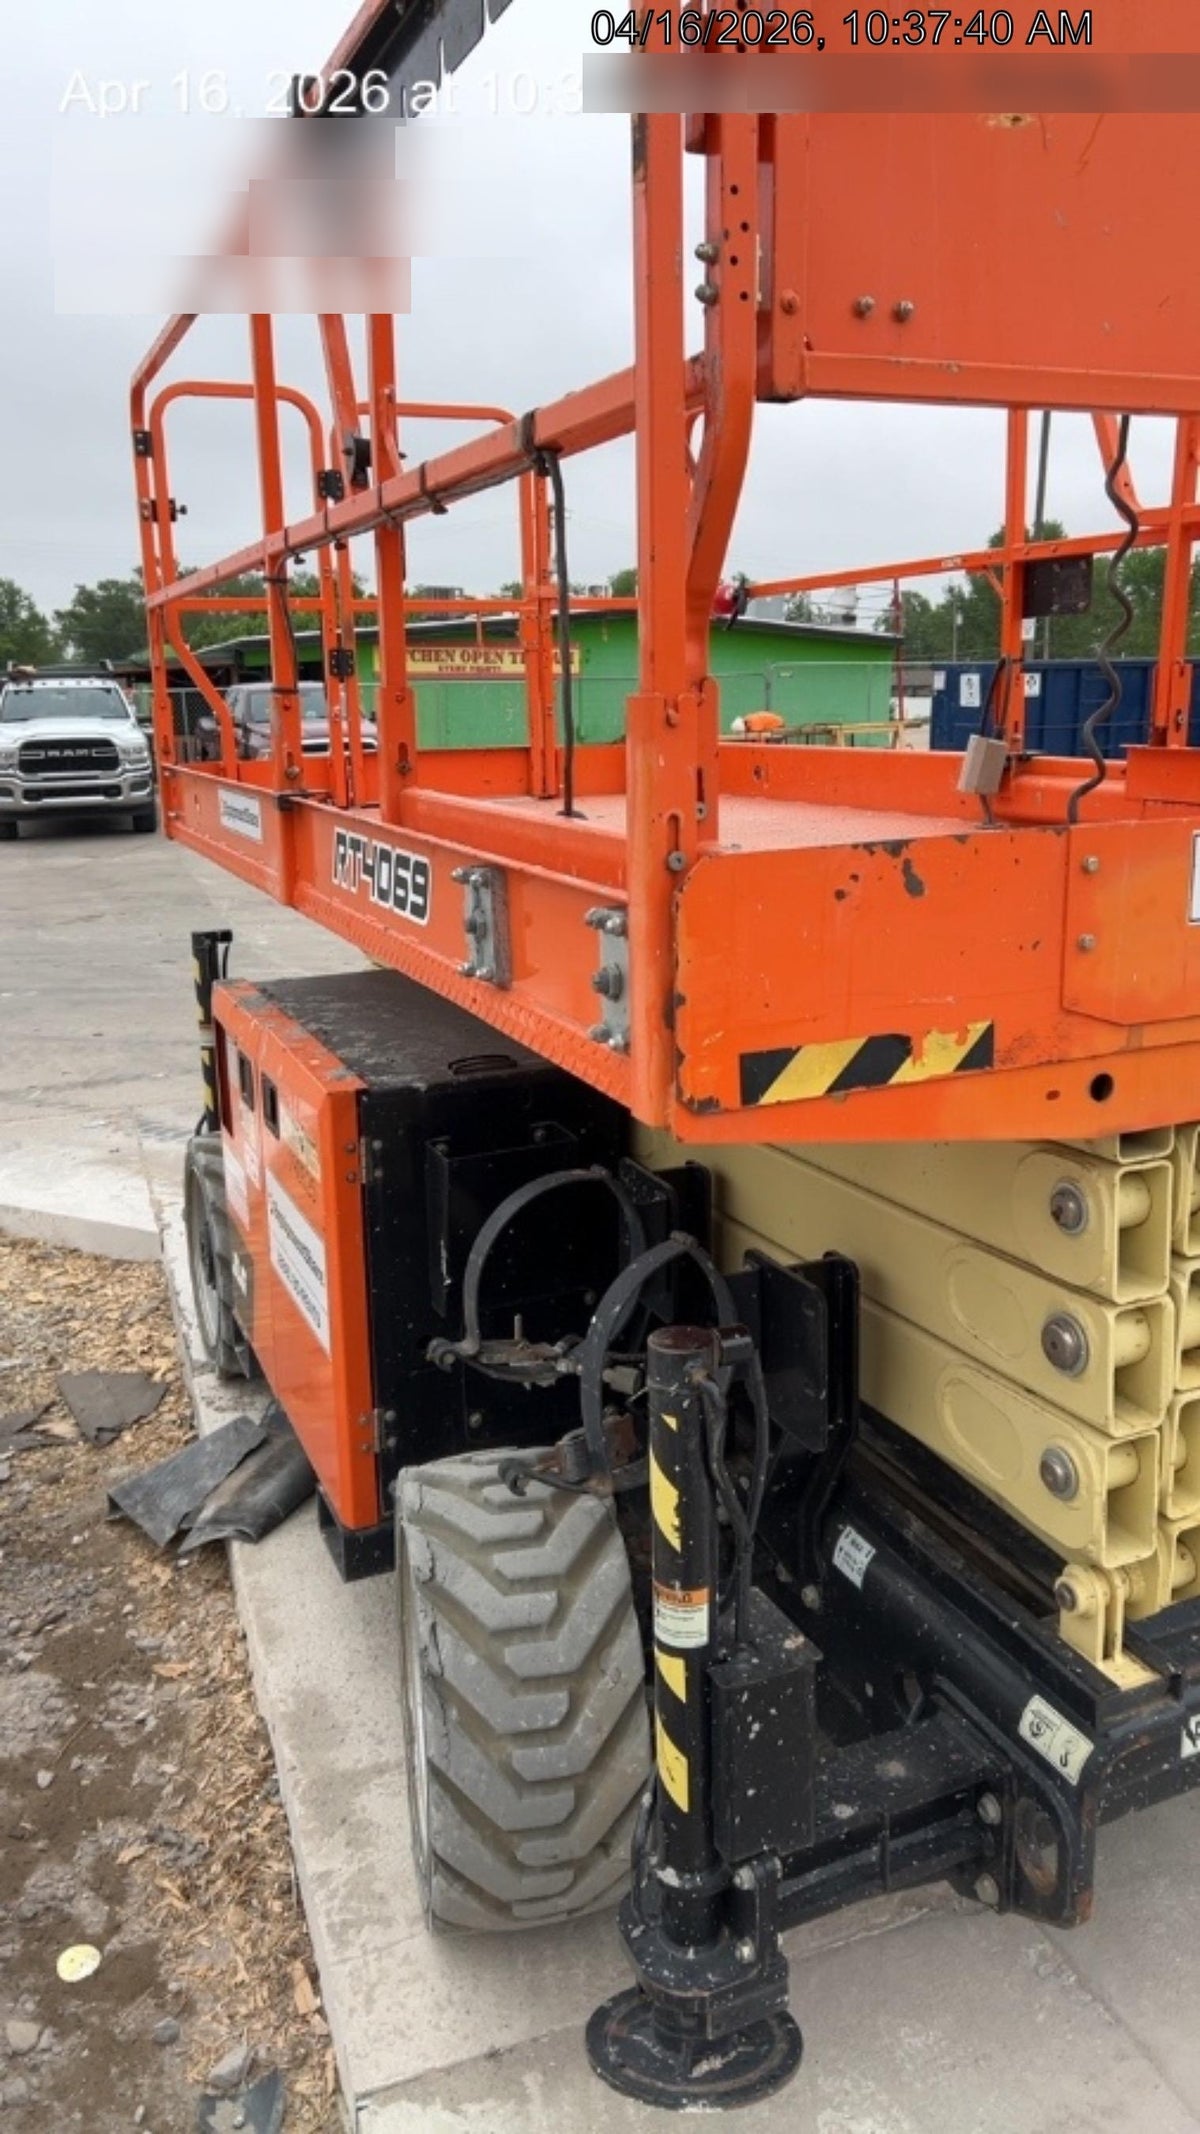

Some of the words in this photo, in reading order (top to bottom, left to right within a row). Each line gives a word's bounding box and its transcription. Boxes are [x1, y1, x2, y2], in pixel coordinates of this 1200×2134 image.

[409, 648, 456, 663] CHEN
[460, 649, 504, 664] OPEN
[47, 748, 88, 757] RAM
[333, 827, 430, 924] RT4069
